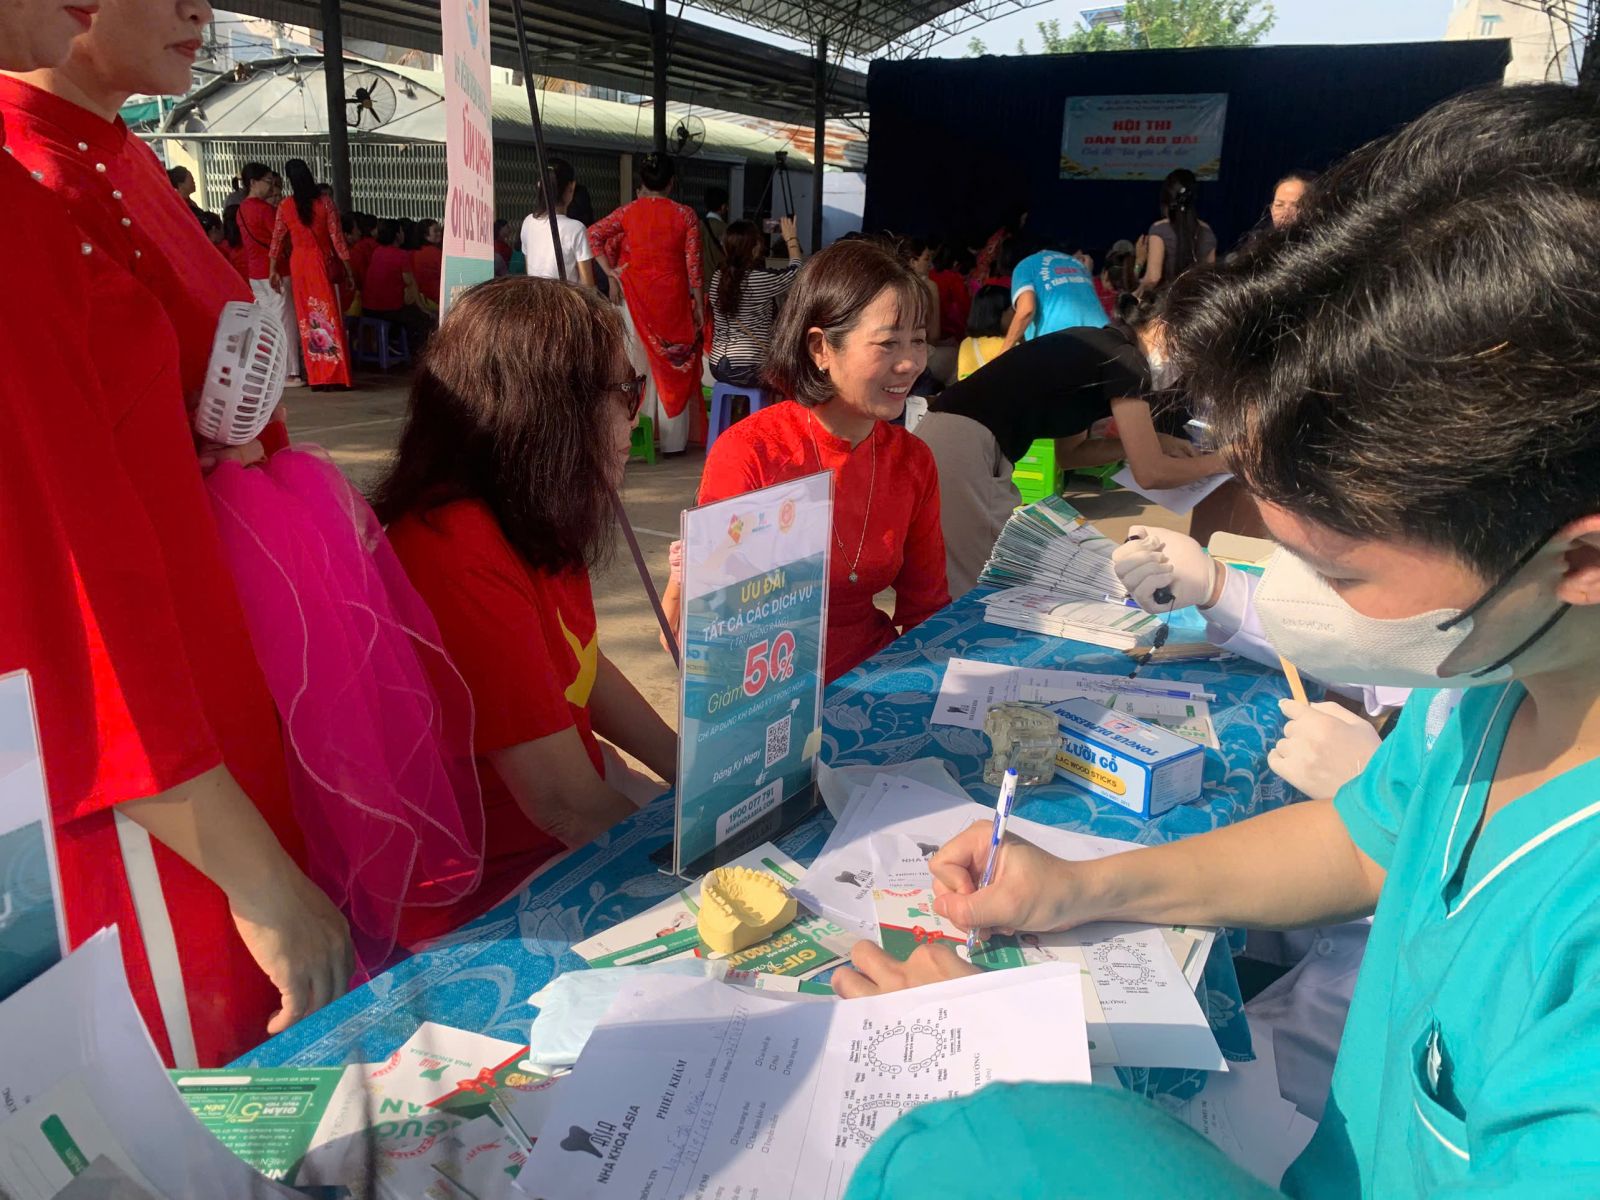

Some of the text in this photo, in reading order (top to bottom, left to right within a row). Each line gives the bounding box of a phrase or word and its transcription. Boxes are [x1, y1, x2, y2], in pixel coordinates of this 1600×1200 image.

[1112, 118, 1173, 132] HỘI THI
[741, 569, 786, 603] ƯU ĐÃI
[703, 586, 813, 642] TẤT CẢ CÁC DỊCH VỤ
[708, 685, 744, 714] Giảm
[720, 715, 737, 732] DỤNG
[738, 710, 748, 721] KHI
[1054, 708, 1159, 756] TONGUE DEPRESSOR
[713, 767, 732, 783] Đăng
[744, 749, 762, 766] Ngay
[1066, 742, 1118, 772] LƯỠI GỖ
[1070, 761, 1090, 774] WOOD
[1090, 770, 1117, 788] STICKS
[729, 787, 774, 824] 1900 077 791
[656, 1091, 675, 1120] PHIẾU
[668, 1059, 688, 1088] KHÁM
[263, 1106, 297, 1115] GIẢM
[590, 1120, 617, 1148] ASIA
[597, 1104, 640, 1184] NHA KHOA ASIA
